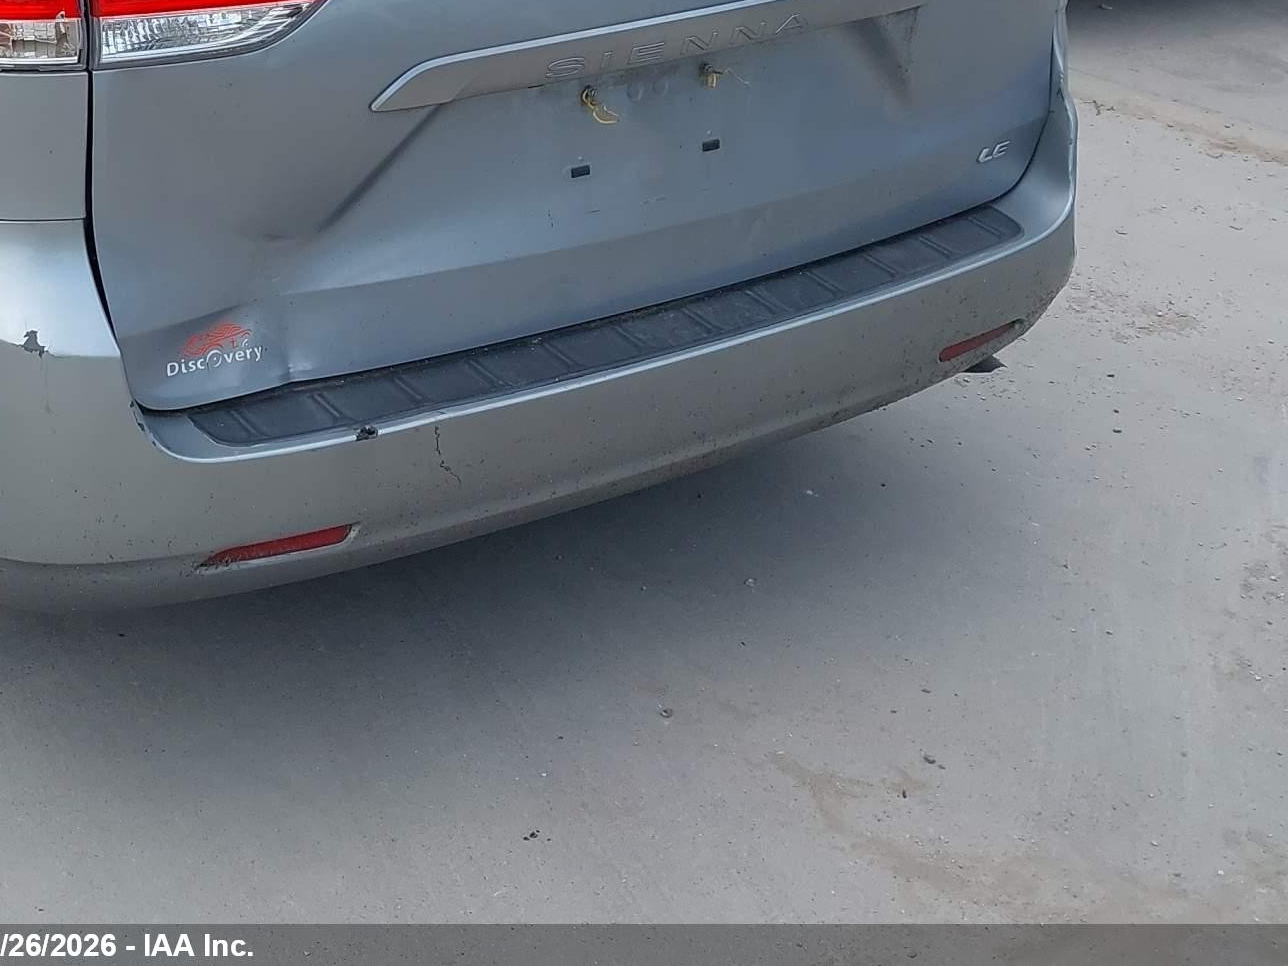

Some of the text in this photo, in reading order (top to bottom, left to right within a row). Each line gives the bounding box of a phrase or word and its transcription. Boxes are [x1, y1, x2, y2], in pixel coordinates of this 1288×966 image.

[545, 11, 809, 80] SIENNA
[976, 139, 1011, 163] LE
[166, 344, 263, 377] Discovery
